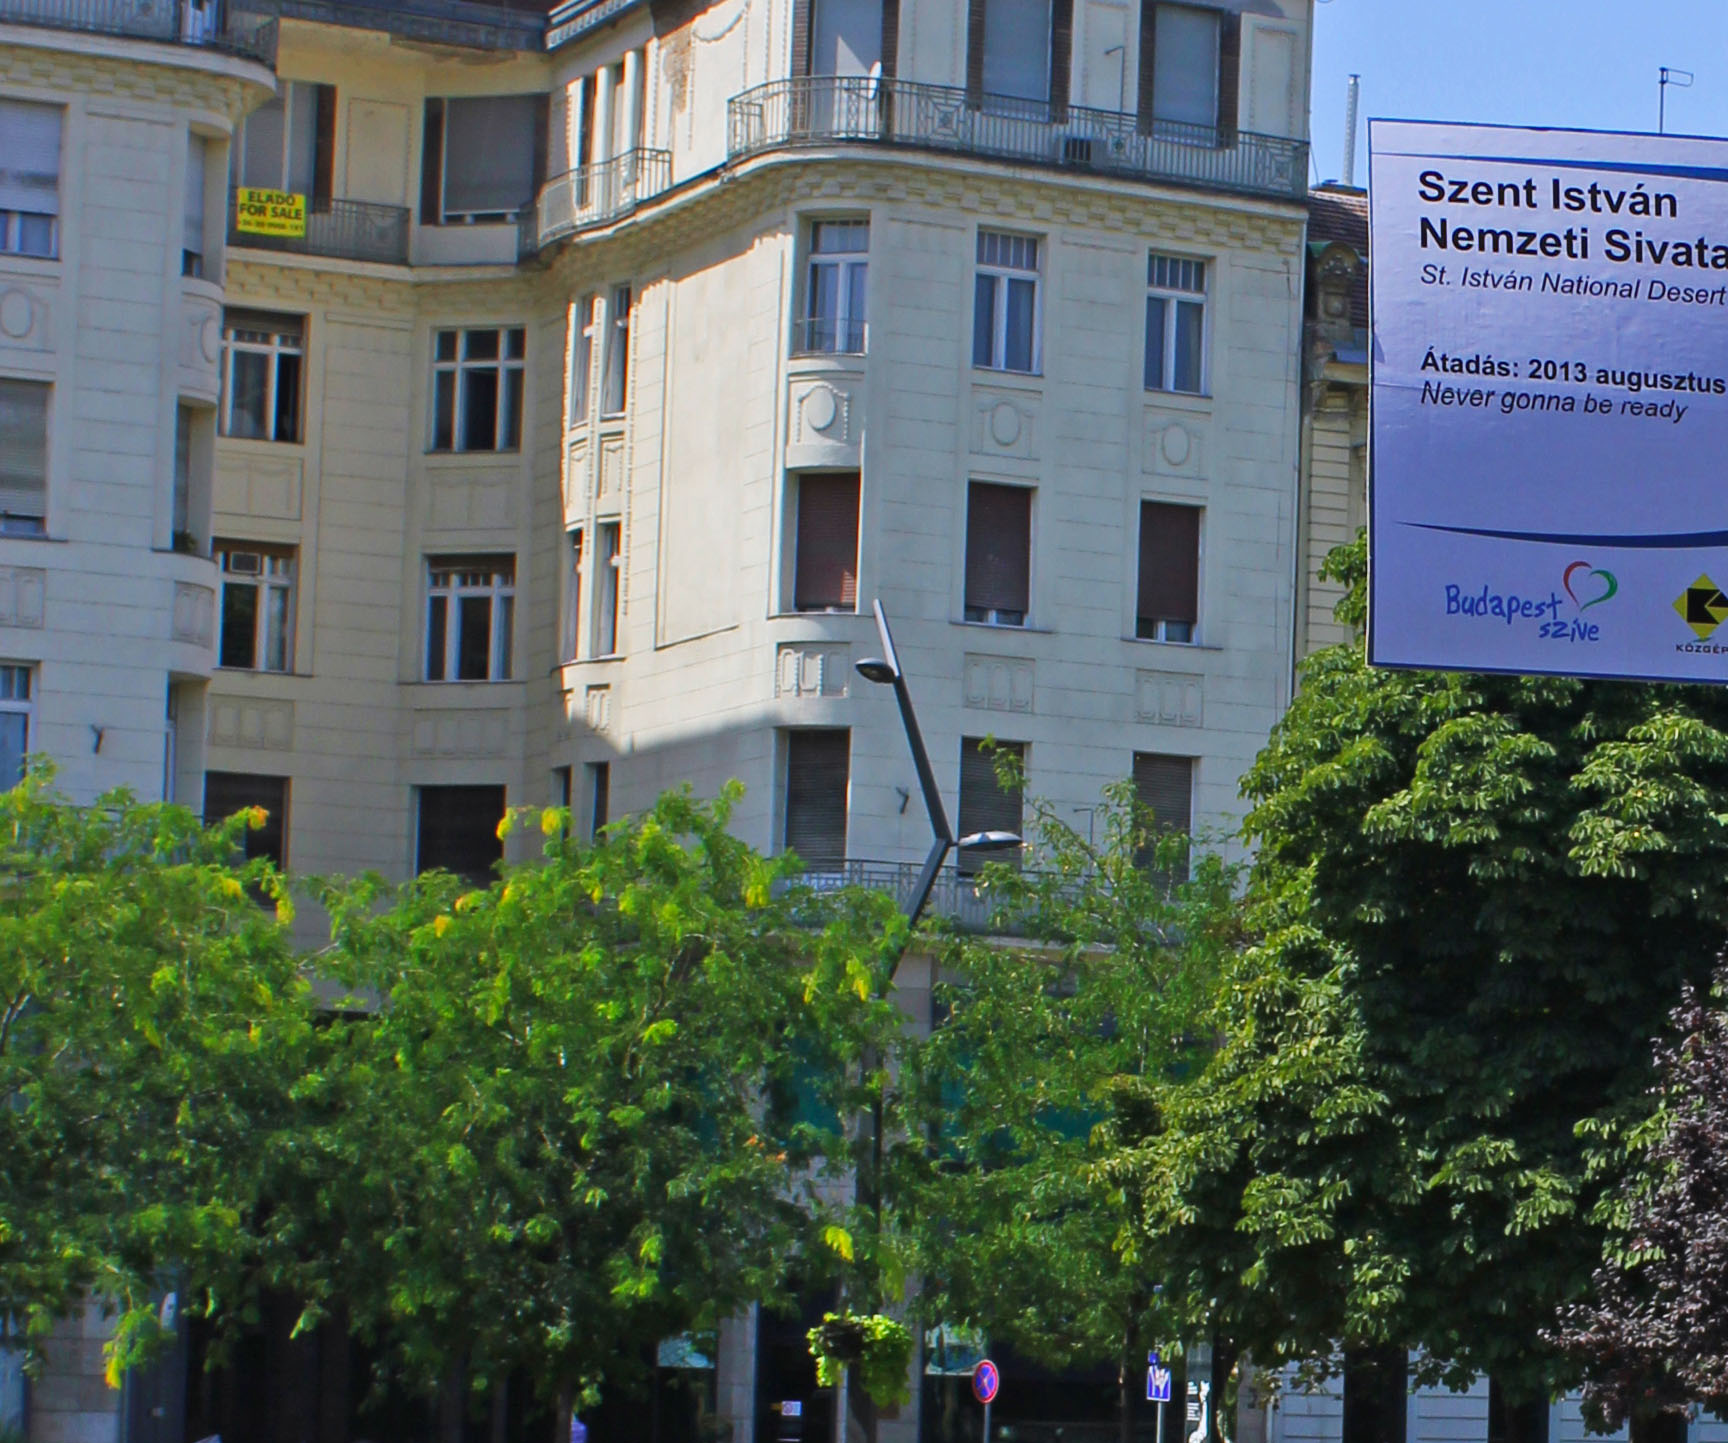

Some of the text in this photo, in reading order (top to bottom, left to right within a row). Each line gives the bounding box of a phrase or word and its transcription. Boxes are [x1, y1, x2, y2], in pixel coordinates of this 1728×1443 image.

[239, 203, 303, 220] FOR SALE
[1418, 171, 1677, 218] Szent István
[1419, 217, 1589, 260] Nemzeti
[1420, 264, 1727, 306] St. István National Desert
[1420, 345, 1519, 378] Átadás:
[1528, 358, 1588, 383] 2013
[1595, 368, 1726, 395] augusztus
[1420, 381, 1689, 424] Never gonna be ready
[1445, 584, 1563, 621] Budapest
